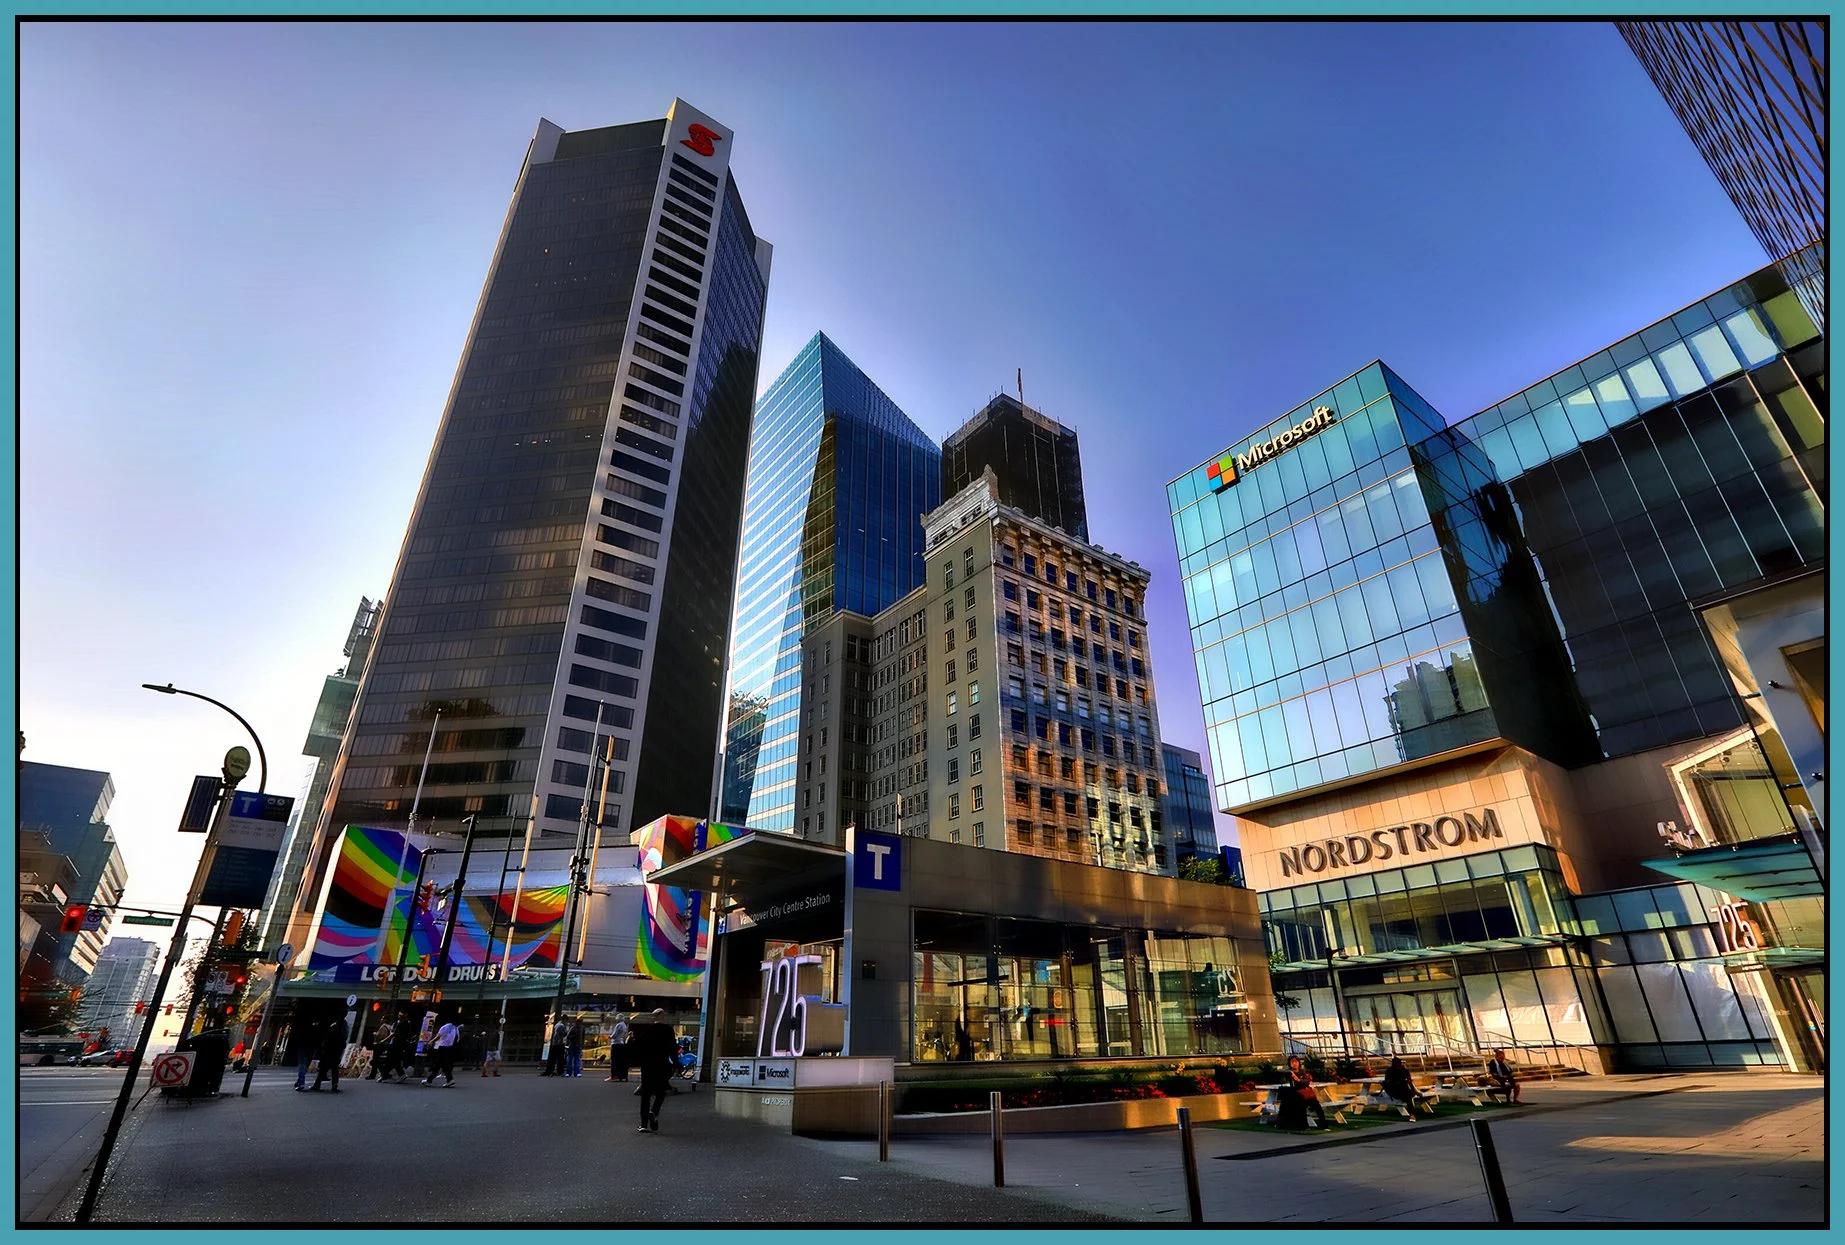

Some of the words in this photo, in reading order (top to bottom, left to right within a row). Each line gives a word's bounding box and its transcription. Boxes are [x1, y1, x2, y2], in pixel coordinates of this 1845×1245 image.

[1237, 405, 1334, 470] Microsoft
[866, 843, 891, 880] T
[1279, 807, 1503, 878] NORDSTROM
[769, 905, 781, 918] City
[782, 901, 804, 915] Centre
[805, 893, 831, 909] Station
[1709, 901, 1759, 952] 725
[447, 963, 497, 981] DRUGS
[757, 955, 810, 1057] 725
[766, 1067, 790, 1079] Microsoft
